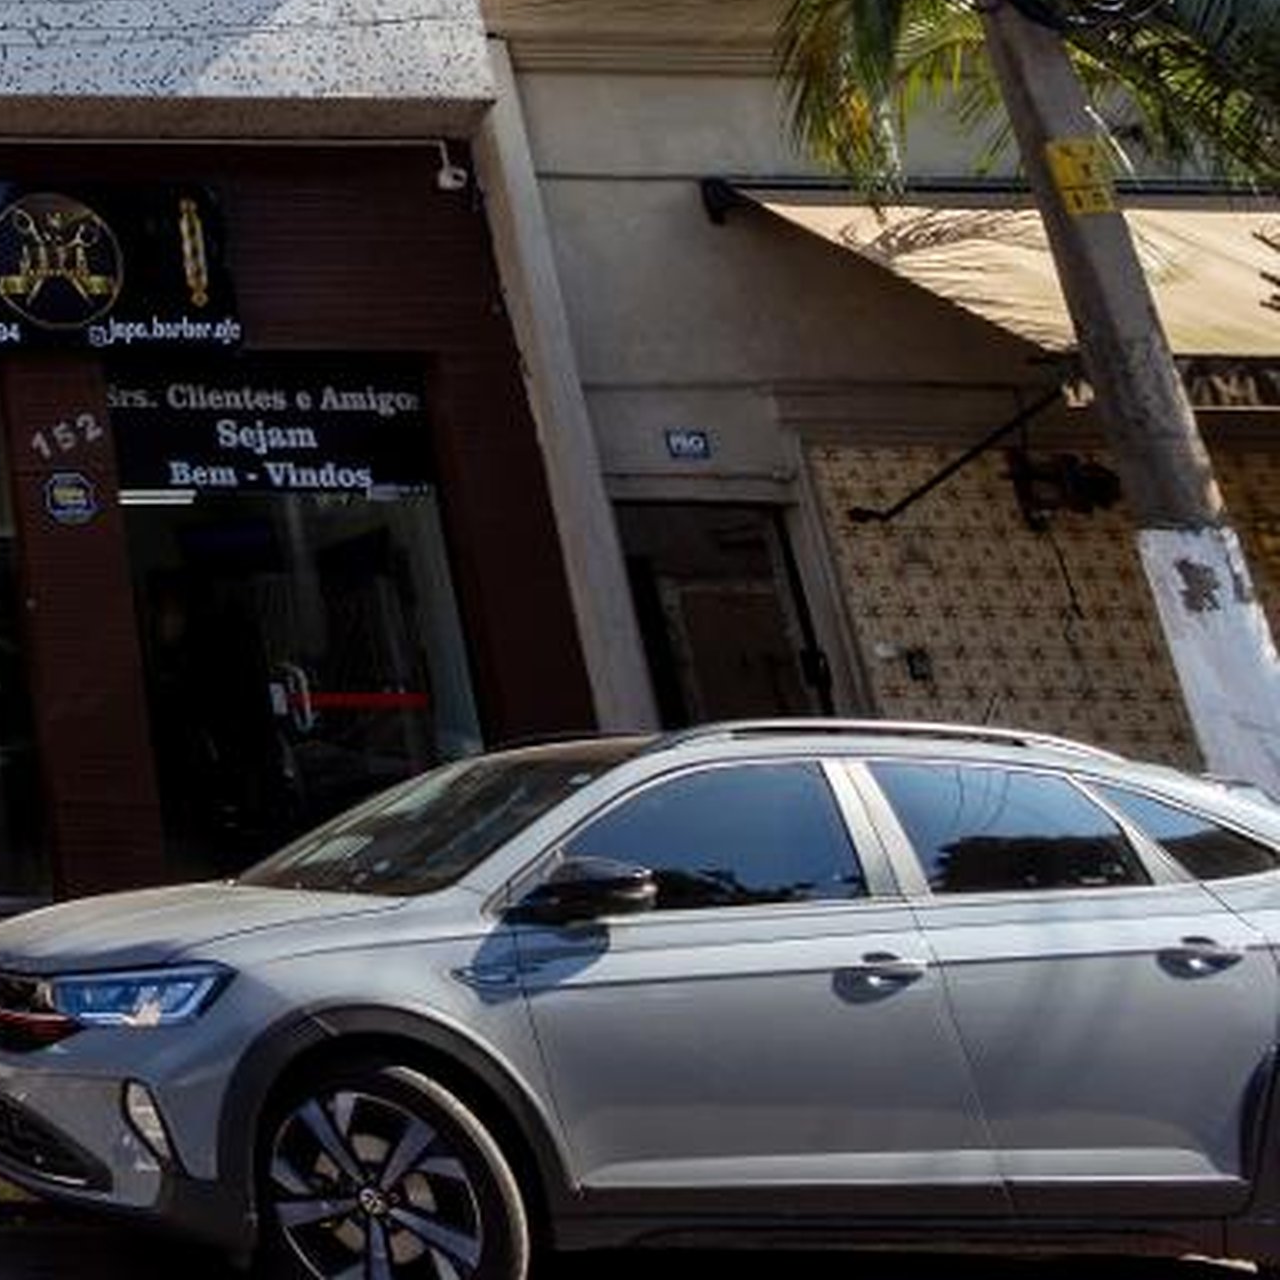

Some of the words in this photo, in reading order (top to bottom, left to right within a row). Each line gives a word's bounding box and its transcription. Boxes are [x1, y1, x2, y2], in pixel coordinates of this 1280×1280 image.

[166, 382, 287, 411] Clientes
[295, 390, 312, 412] e
[31, 413, 103, 459] 152
[215, 419, 318, 455] Sejam
[168, 460, 239, 487] Bem
[262, 461, 374, 489] Vindos
